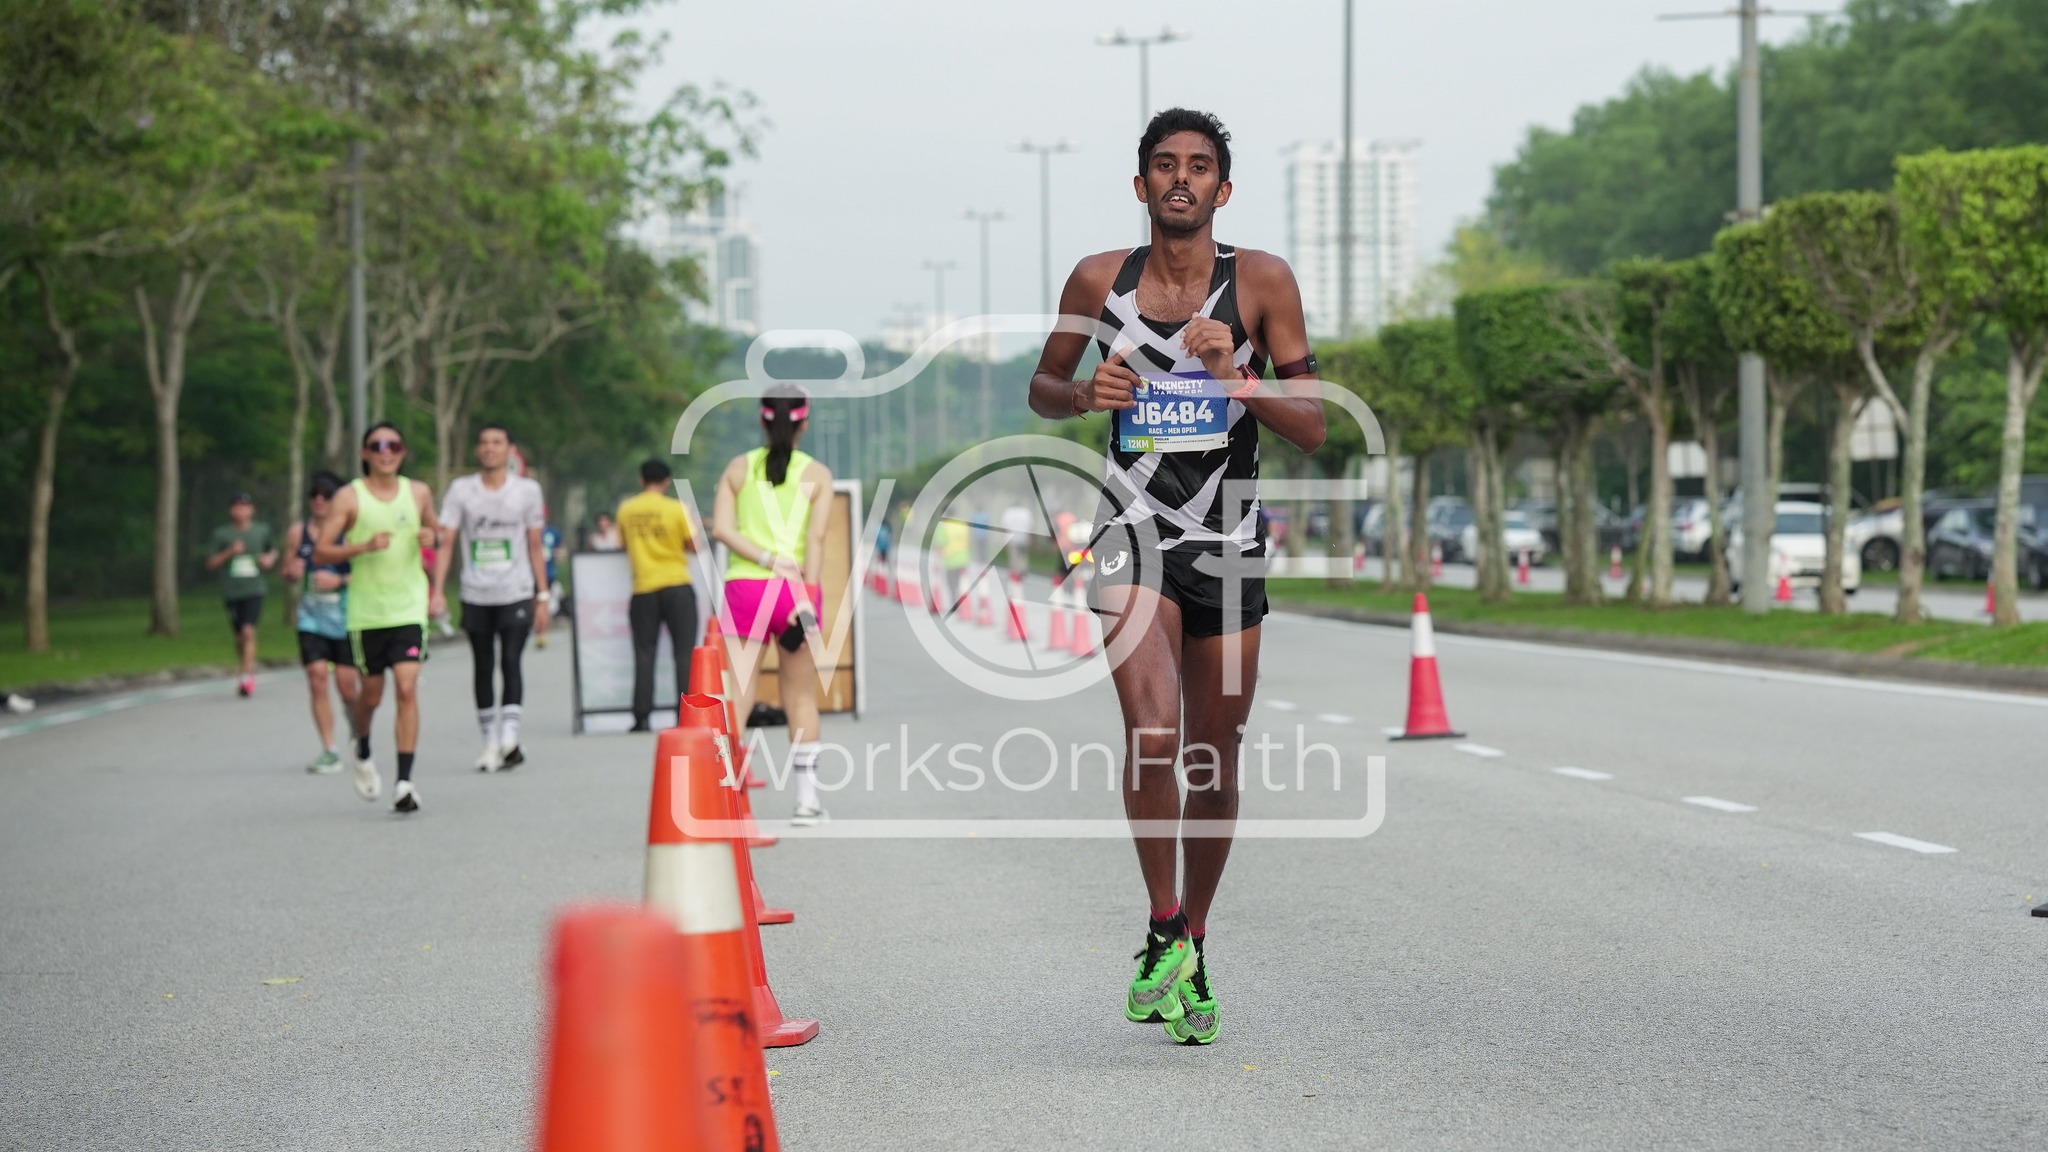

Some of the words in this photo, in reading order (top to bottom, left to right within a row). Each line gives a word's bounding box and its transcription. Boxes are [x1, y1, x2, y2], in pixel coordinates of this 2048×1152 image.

[1151, 380, 1204, 390] TWINCITY
[1132, 400, 1214, 425] J6484
[1127, 439, 1149, 449] 12KM
